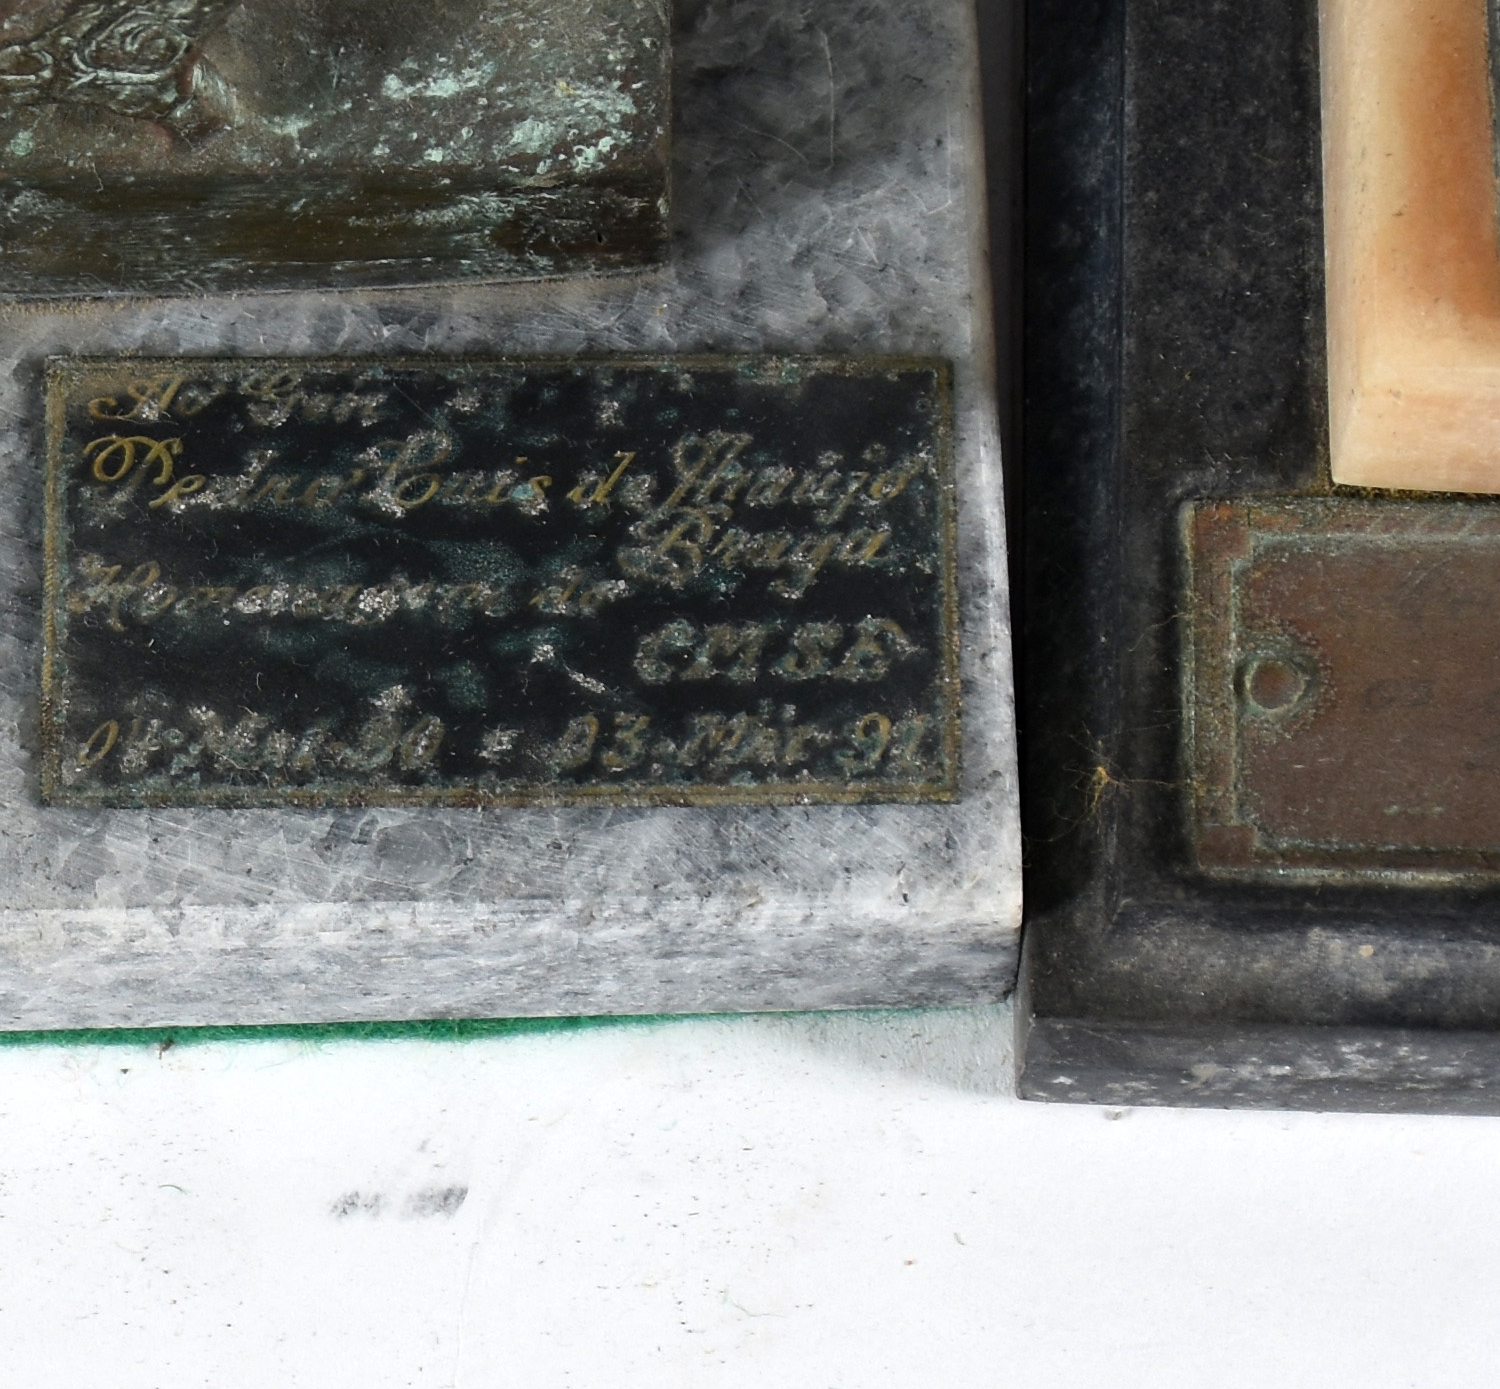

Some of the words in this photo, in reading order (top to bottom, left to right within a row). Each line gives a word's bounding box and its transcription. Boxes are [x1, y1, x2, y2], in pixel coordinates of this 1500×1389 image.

[82, 434, 362, 520] Pedro
[566, 450, 658, 512] de
[617, 505, 894, 600] Braga
[632, 617, 922, 686] CMSE
